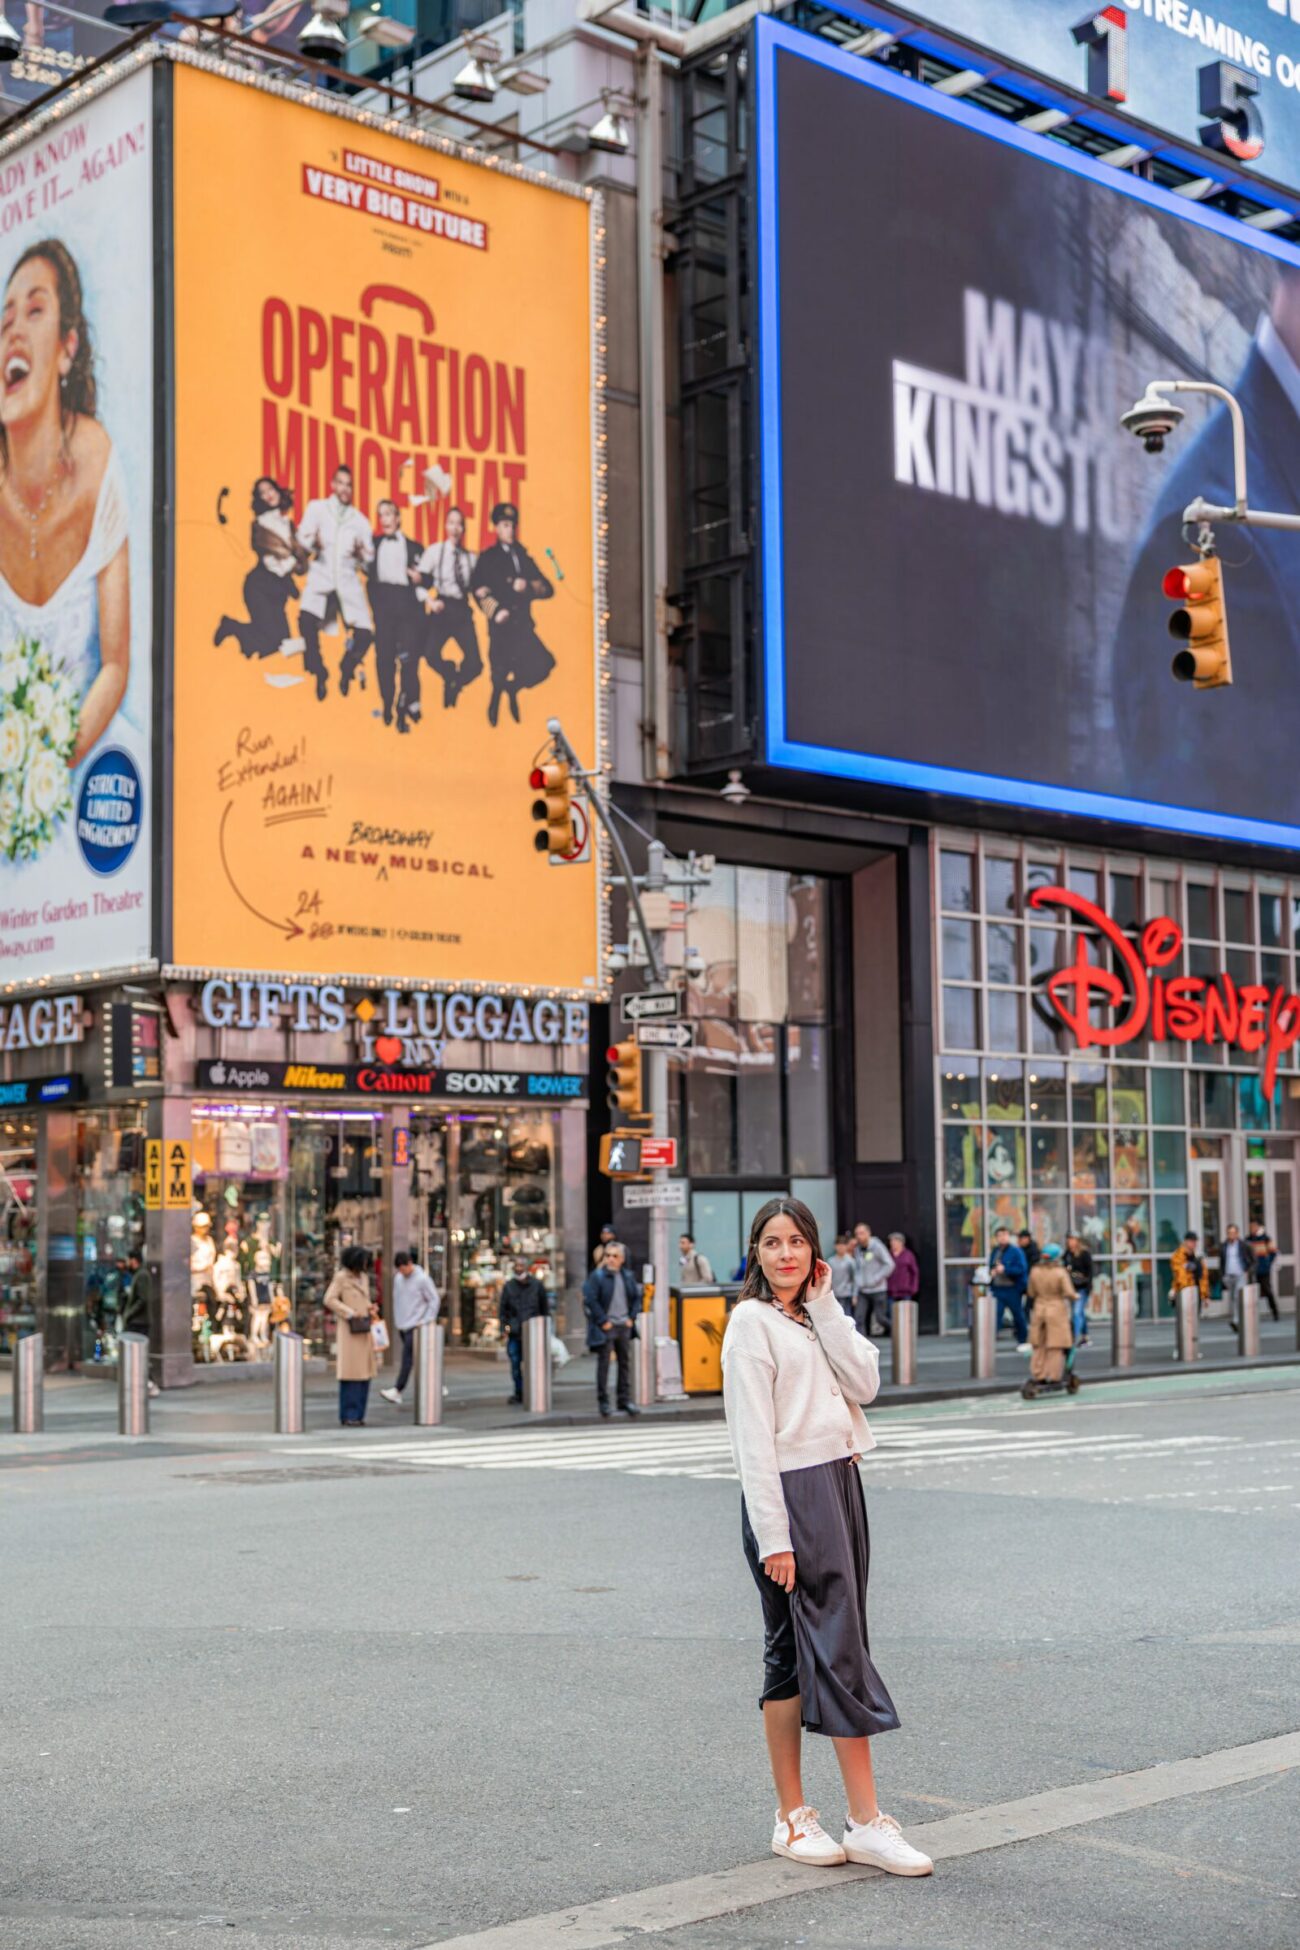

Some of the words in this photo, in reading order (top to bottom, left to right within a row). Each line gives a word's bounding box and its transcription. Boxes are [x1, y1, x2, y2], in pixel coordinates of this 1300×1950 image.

[33, 119, 90, 179] KNOW
[0, 188, 36, 234] OVE
[78, 122, 145, 191] AGAIN!
[345, 152, 393, 185] LITTLE
[394, 168, 438, 200] SHOW
[306, 167, 364, 208] VERY
[365, 187, 405, 222] BIG
[406, 200, 485, 249] FUTURE
[261, 295, 527, 457] OPERATION
[217, 735, 307, 793] Extended!
[236, 725, 274, 759] Run
[86, 798, 133, 823] LIMITED
[261, 773, 334, 810] AGAIN!
[348, 820, 434, 850] BROADWAY
[301, 844, 315, 860] A
[326, 847, 379, 866] NEW
[389, 854, 495, 880] MUSICAL
[42, 898, 89, 924] Garden
[92, 889, 144, 916] Theatre
[201, 979, 346, 1033] GIFTS
[383, 989, 590, 1044] LUGGAGE
[362, 1036, 375, 1063] I
[401, 1038, 447, 1068] NY
[228, 1067, 269, 1088] Apple
[283, 1066, 346, 1089] Nikon
[356, 1069, 432, 1094] Canon
[445, 1073, 519, 1094] SONY
[527, 1075, 583, 1096] BOWER
[148, 1144, 160, 1198] ATM
[169, 1143, 187, 1198] ATM
